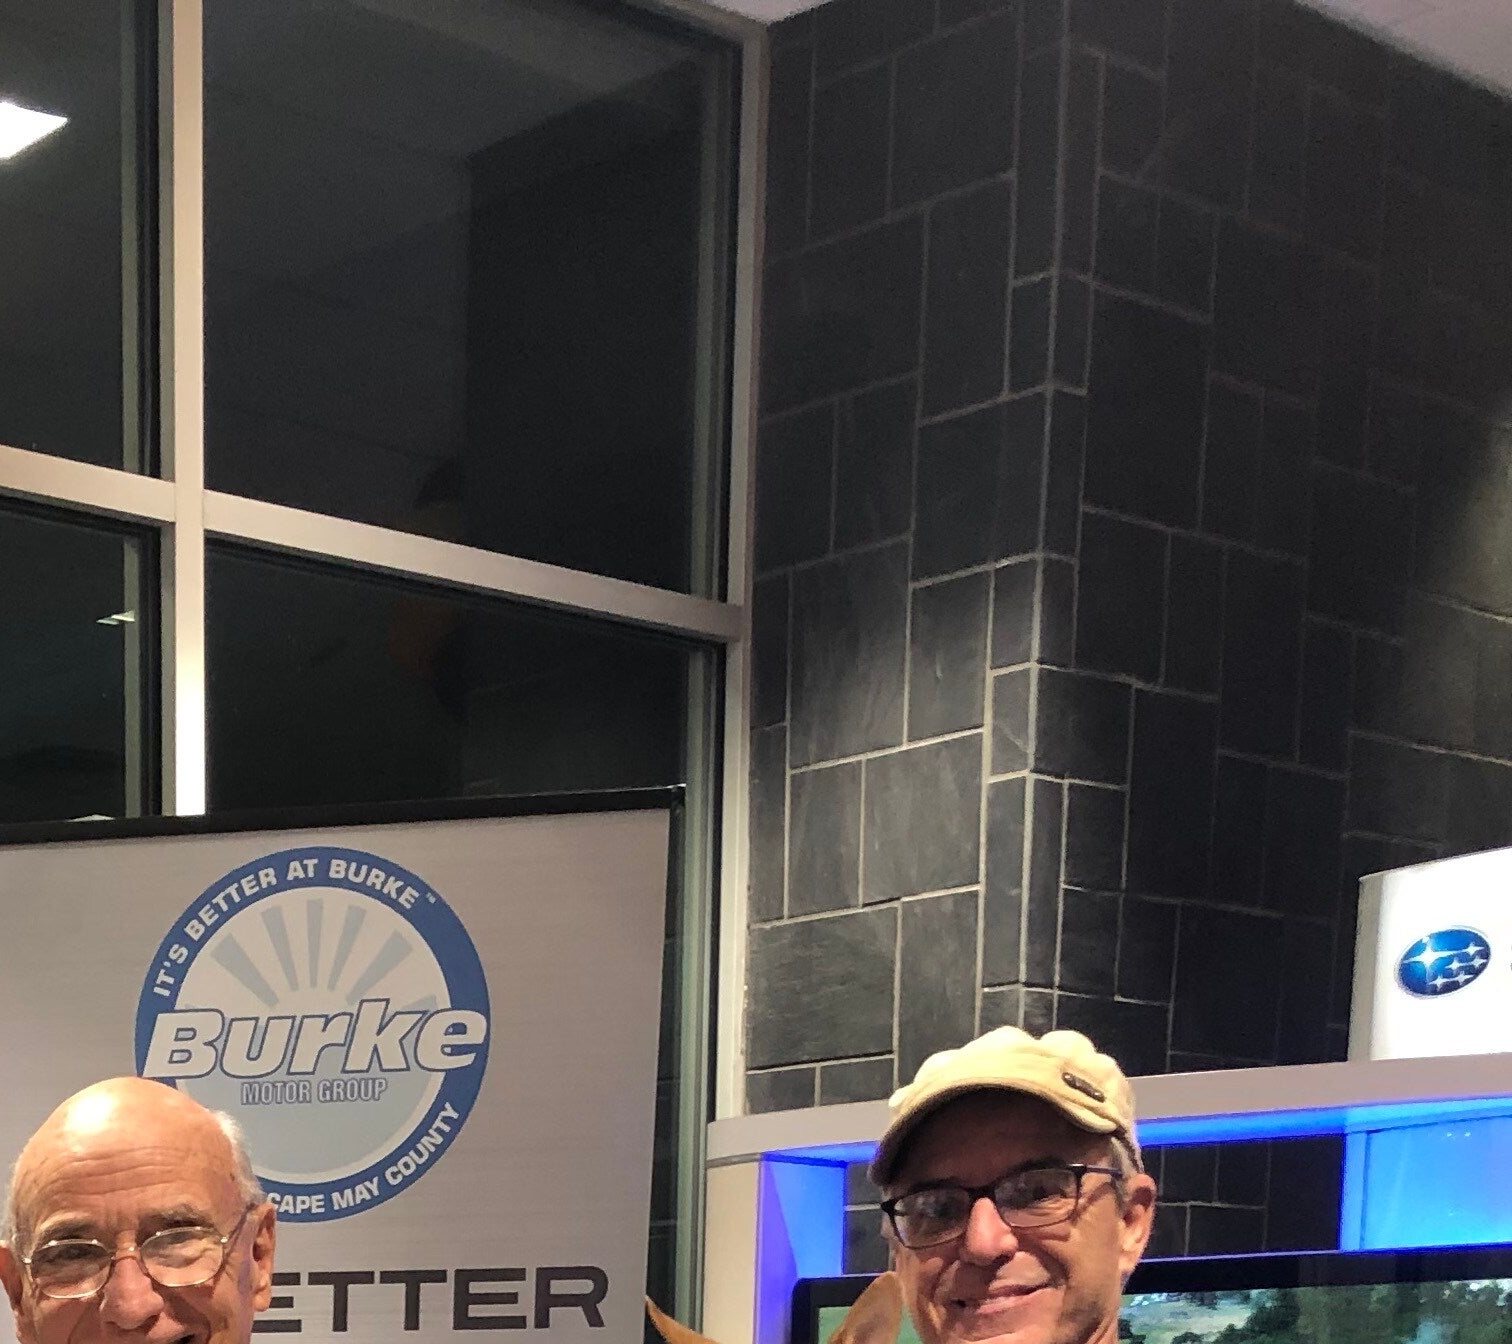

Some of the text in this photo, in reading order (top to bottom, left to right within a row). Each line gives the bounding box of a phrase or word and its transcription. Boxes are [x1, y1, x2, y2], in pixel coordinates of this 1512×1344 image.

[153, 943, 188, 997] IT'S
[184, 867, 277, 941] BETTER
[287, 858, 318, 882] AT
[143, 998, 487, 1079] Burke
[241, 1078, 387, 1106] MOTOR GROUP
[265, 1102, 459, 1214] CAPE MAY COUNTY
[251, 1266, 609, 1333] ETTER
